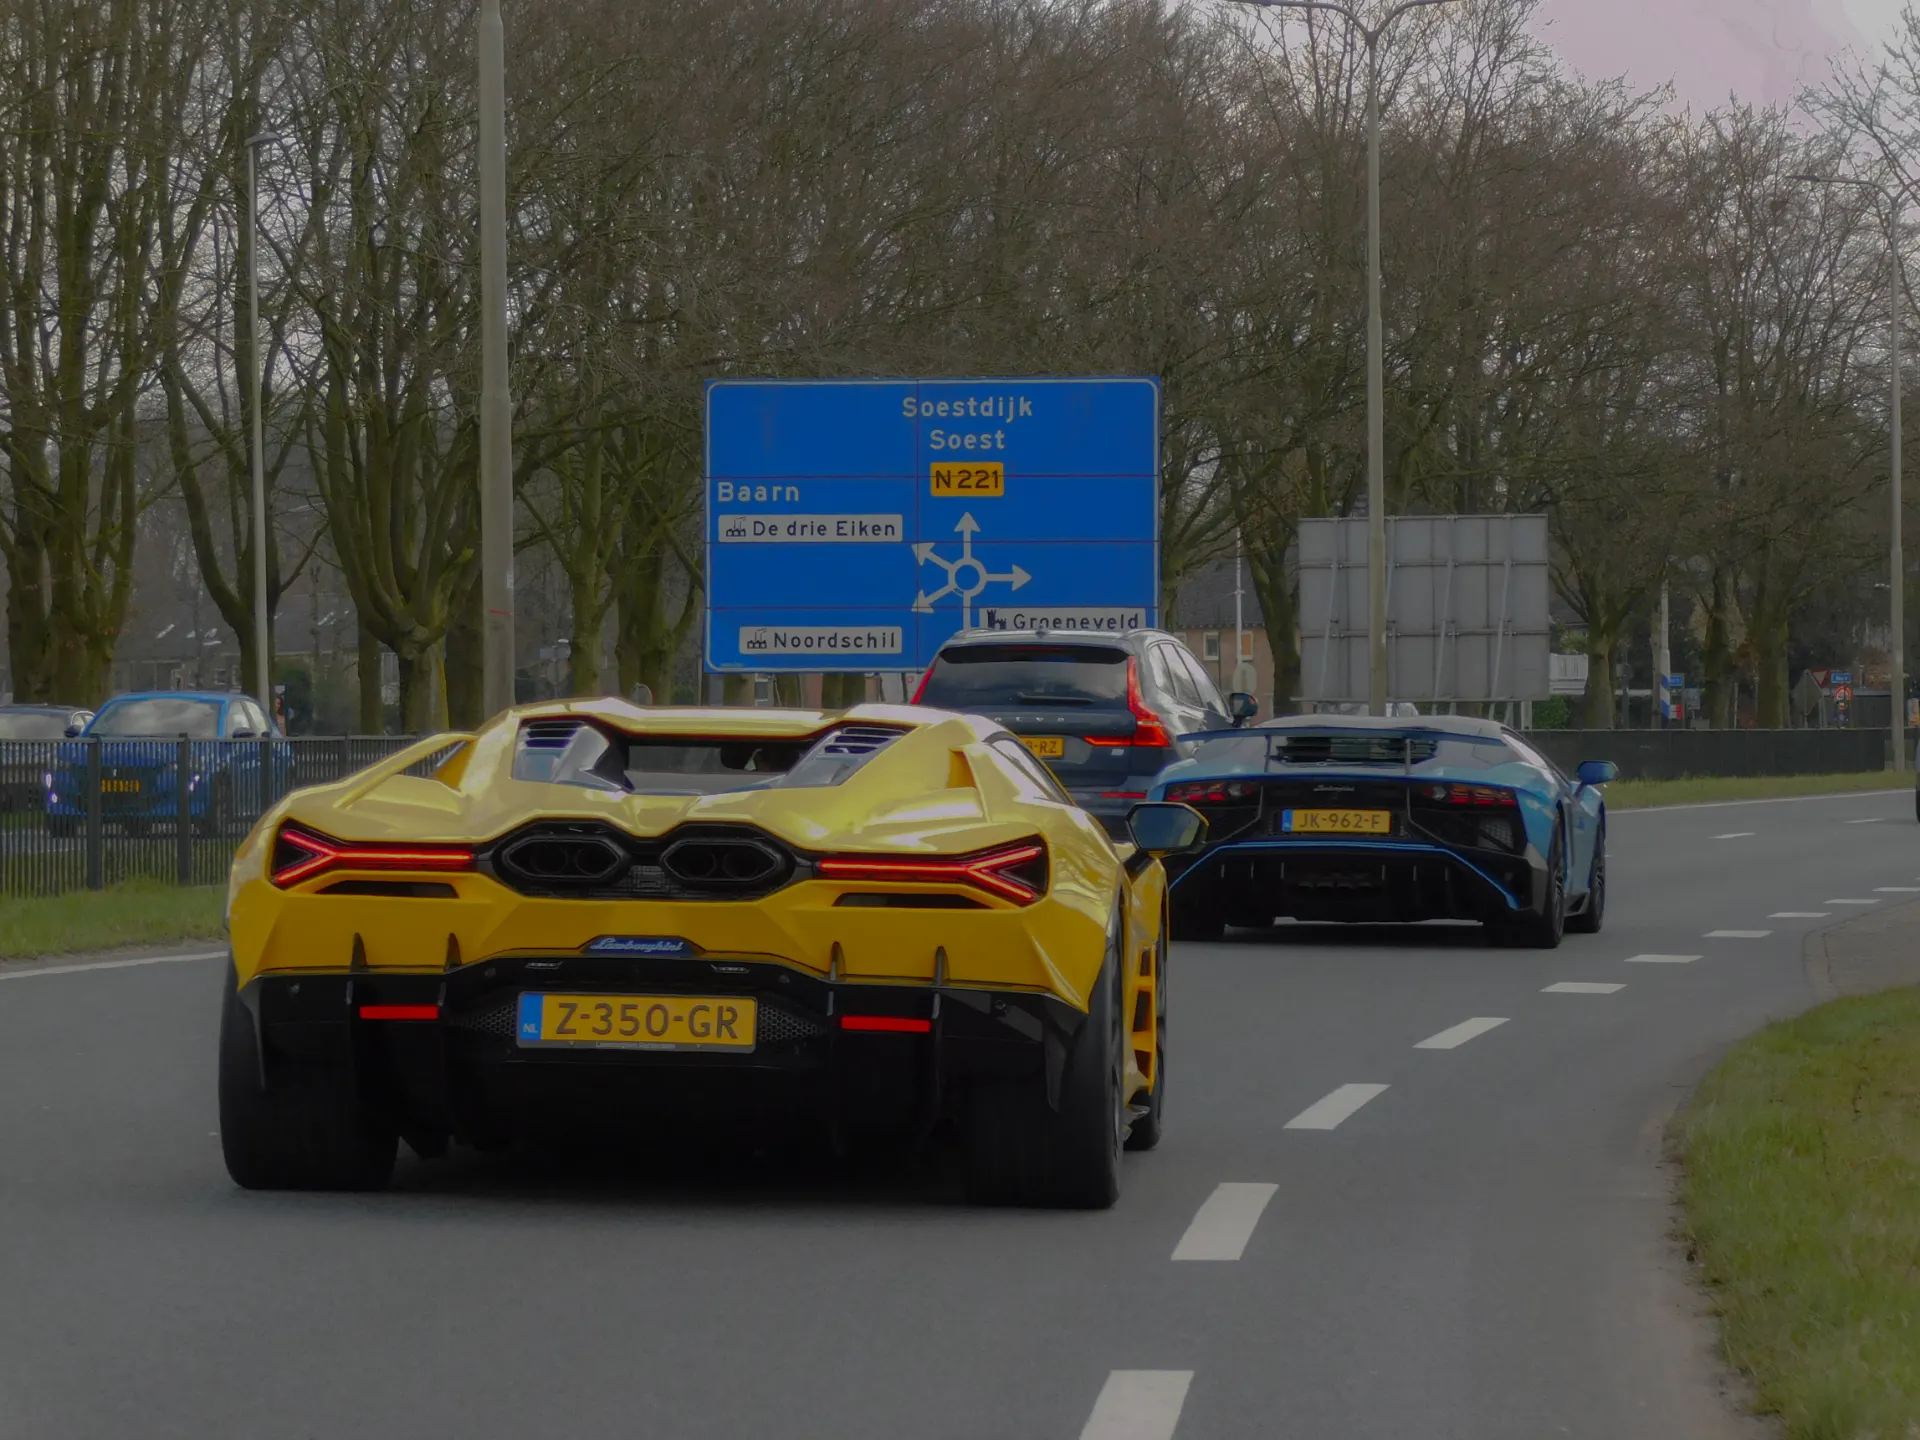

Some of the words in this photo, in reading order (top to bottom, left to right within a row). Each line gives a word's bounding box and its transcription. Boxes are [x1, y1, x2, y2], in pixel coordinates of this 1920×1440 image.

[902, 396, 1033, 423] Soestdijk
[929, 429, 1005, 450] Soest
[717, 482, 800, 502] Baarn
[753, 520, 778, 537] De
[786, 520, 827, 537] drie
[836, 520, 895, 537] Eiken
[1013, 613, 1139, 630] Groeneveld
[774, 631, 895, 649] Noordschil
[1299, 813, 1381, 829] JK-962-F
[555, 1002, 738, 1039] Z-350-GR
